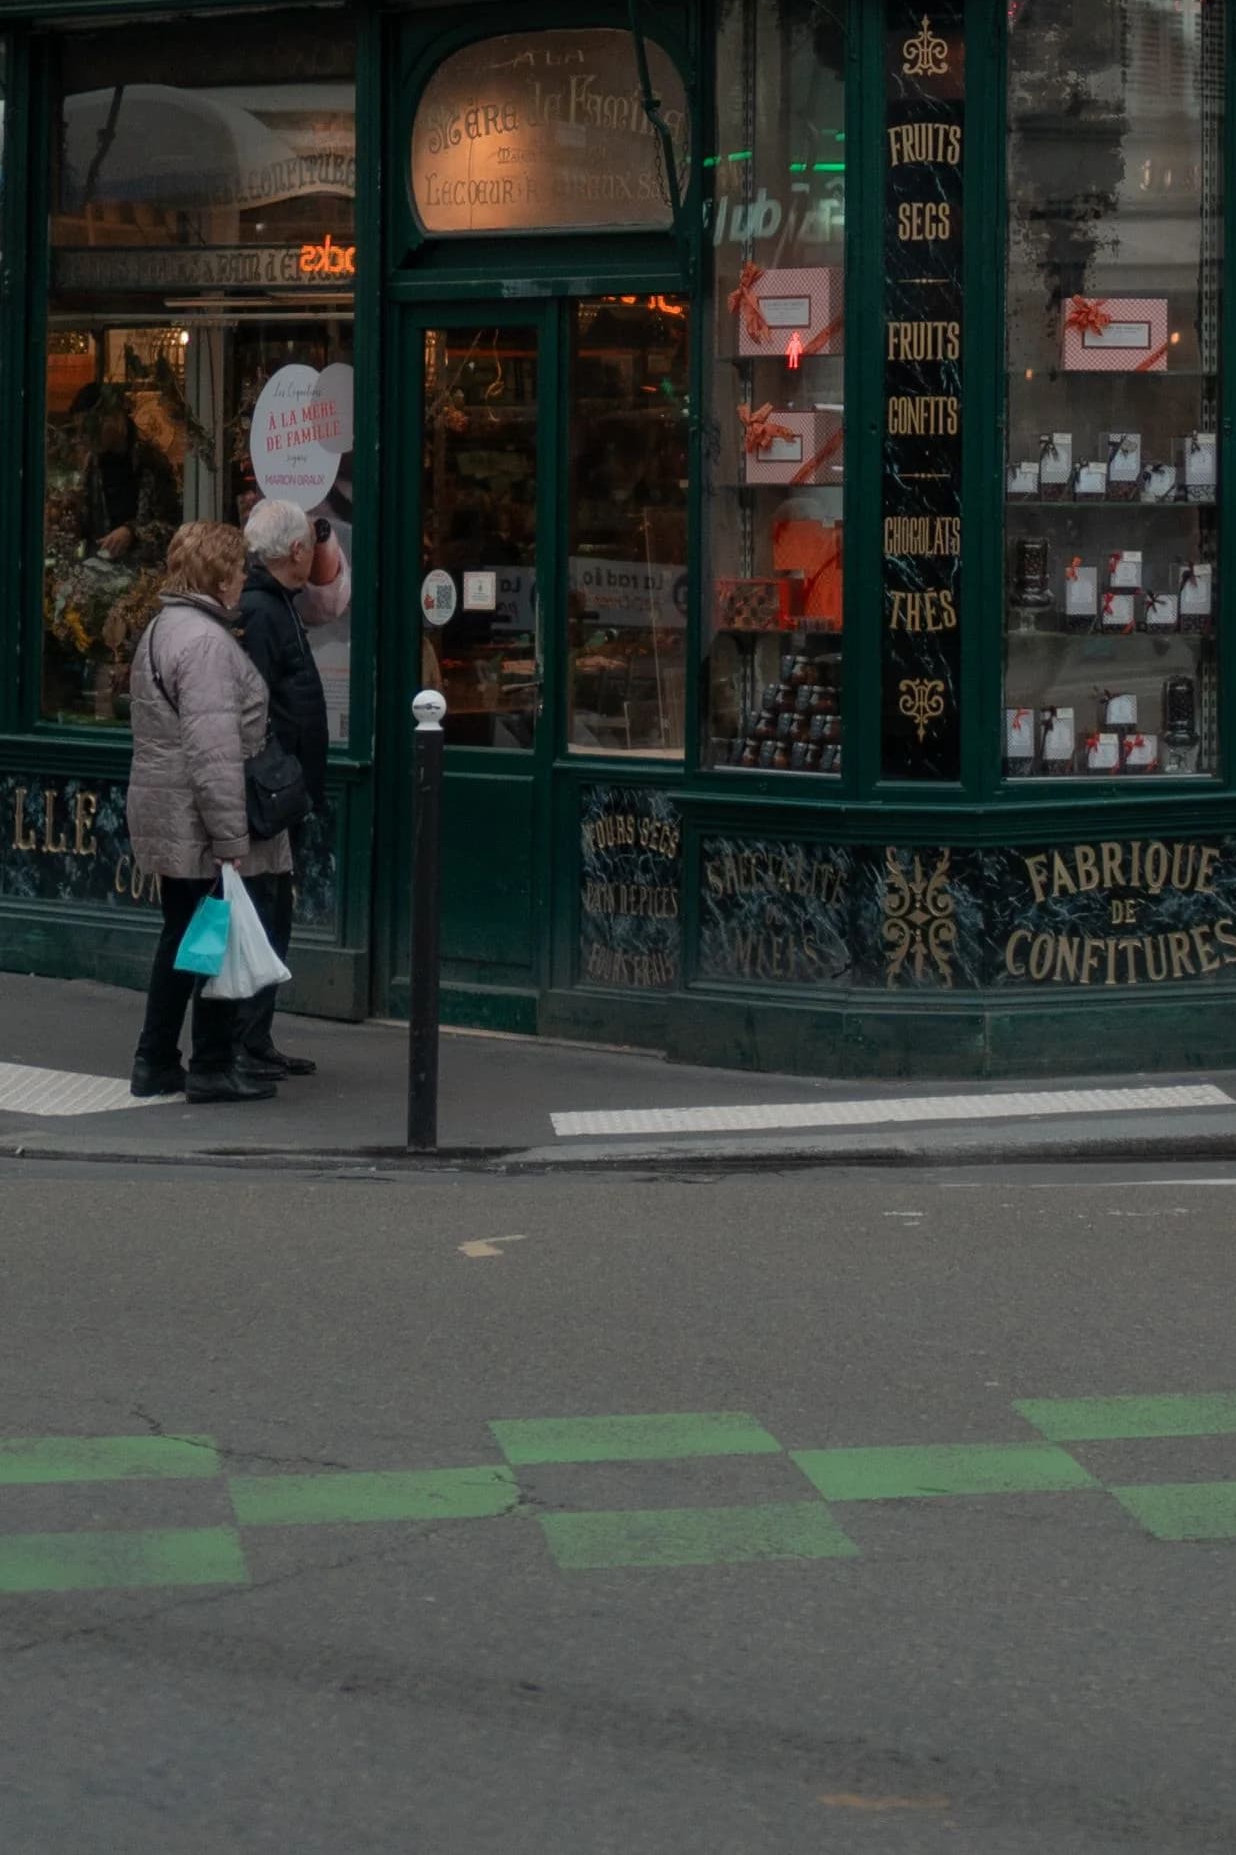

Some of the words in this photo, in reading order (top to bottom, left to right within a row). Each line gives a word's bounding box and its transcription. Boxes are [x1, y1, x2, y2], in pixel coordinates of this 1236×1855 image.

[887, 122, 961, 168] FRUITS
[898, 202, 950, 241] SECS
[887, 321, 960, 362] FRUITS
[287, 420, 342, 447] FAMILLE
[888, 396, 958, 436] CONFITS
[884, 516, 960, 557] CHOCOLATS
[889, 587, 957, 632] THÉS
[1027, 843, 1220, 902] FABRIQUE
[1111, 899, 1136, 925] DE
